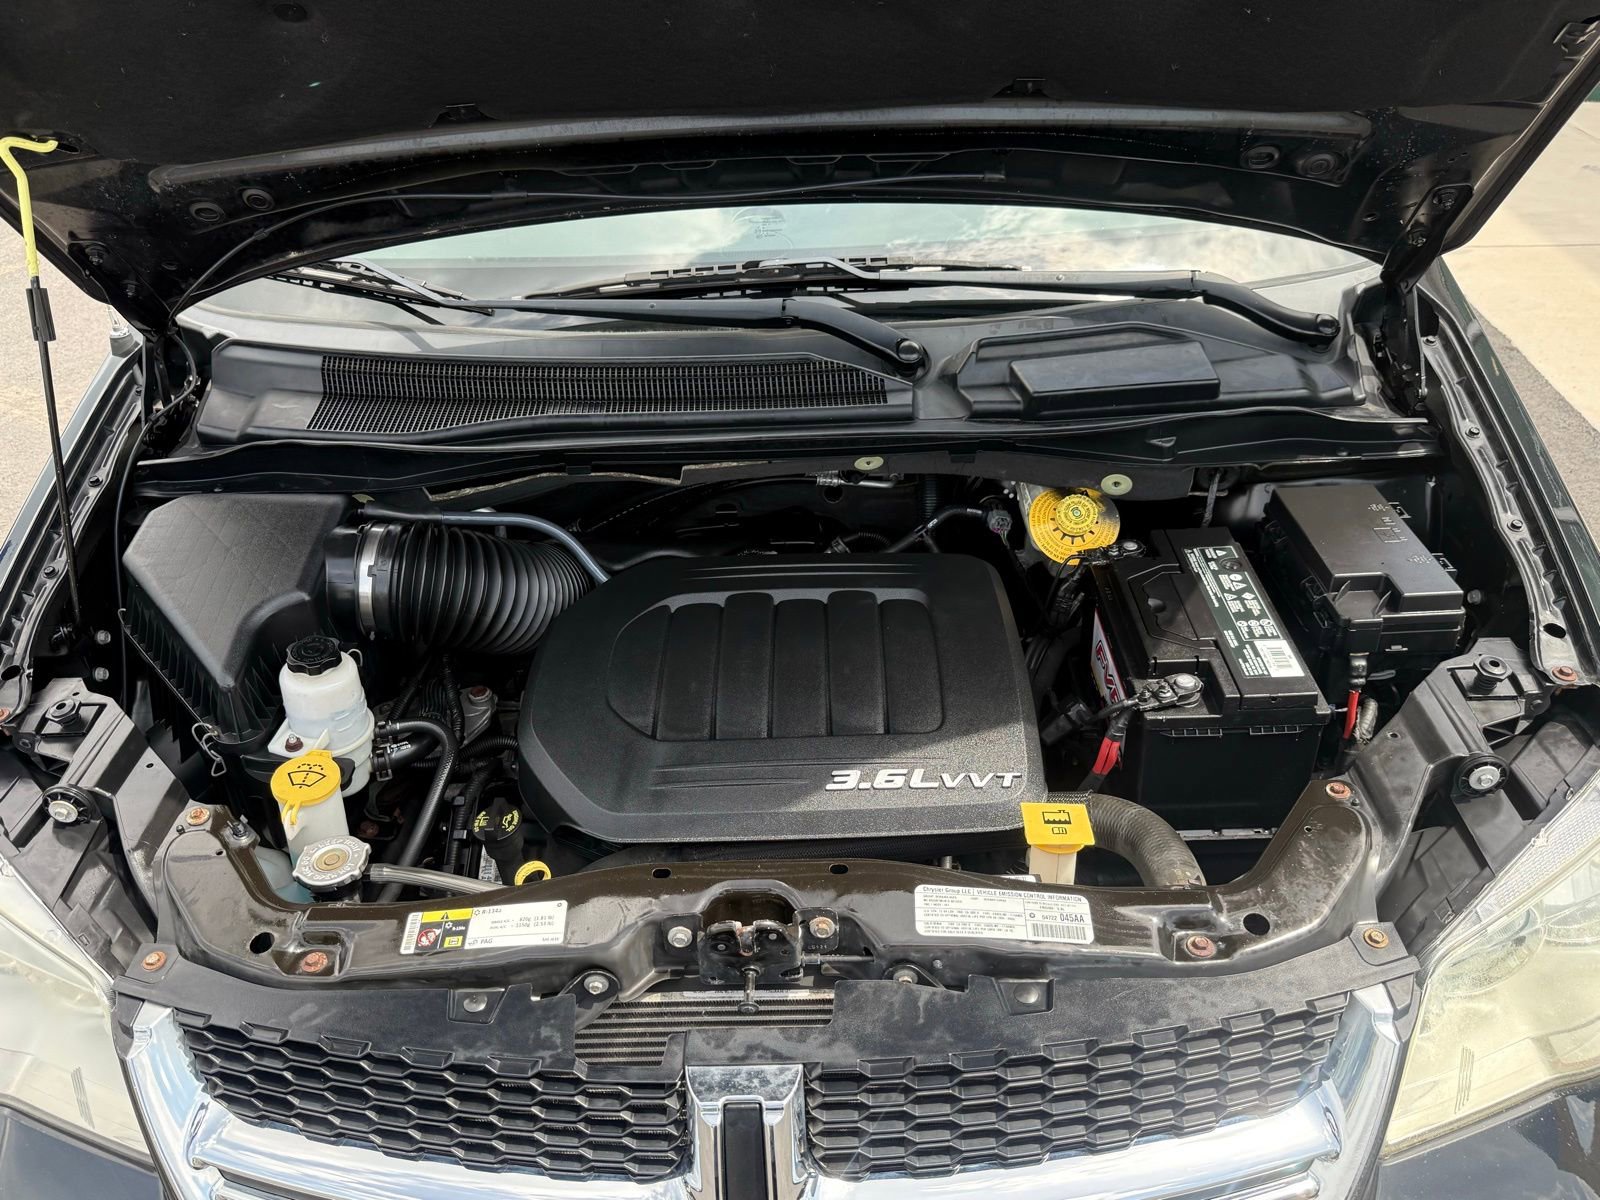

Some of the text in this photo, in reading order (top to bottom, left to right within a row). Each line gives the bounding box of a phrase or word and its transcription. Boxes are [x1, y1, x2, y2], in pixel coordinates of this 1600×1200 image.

[825, 769, 1022, 791] 3.6L VVT
[1060, 914, 1085, 923] 045AA
